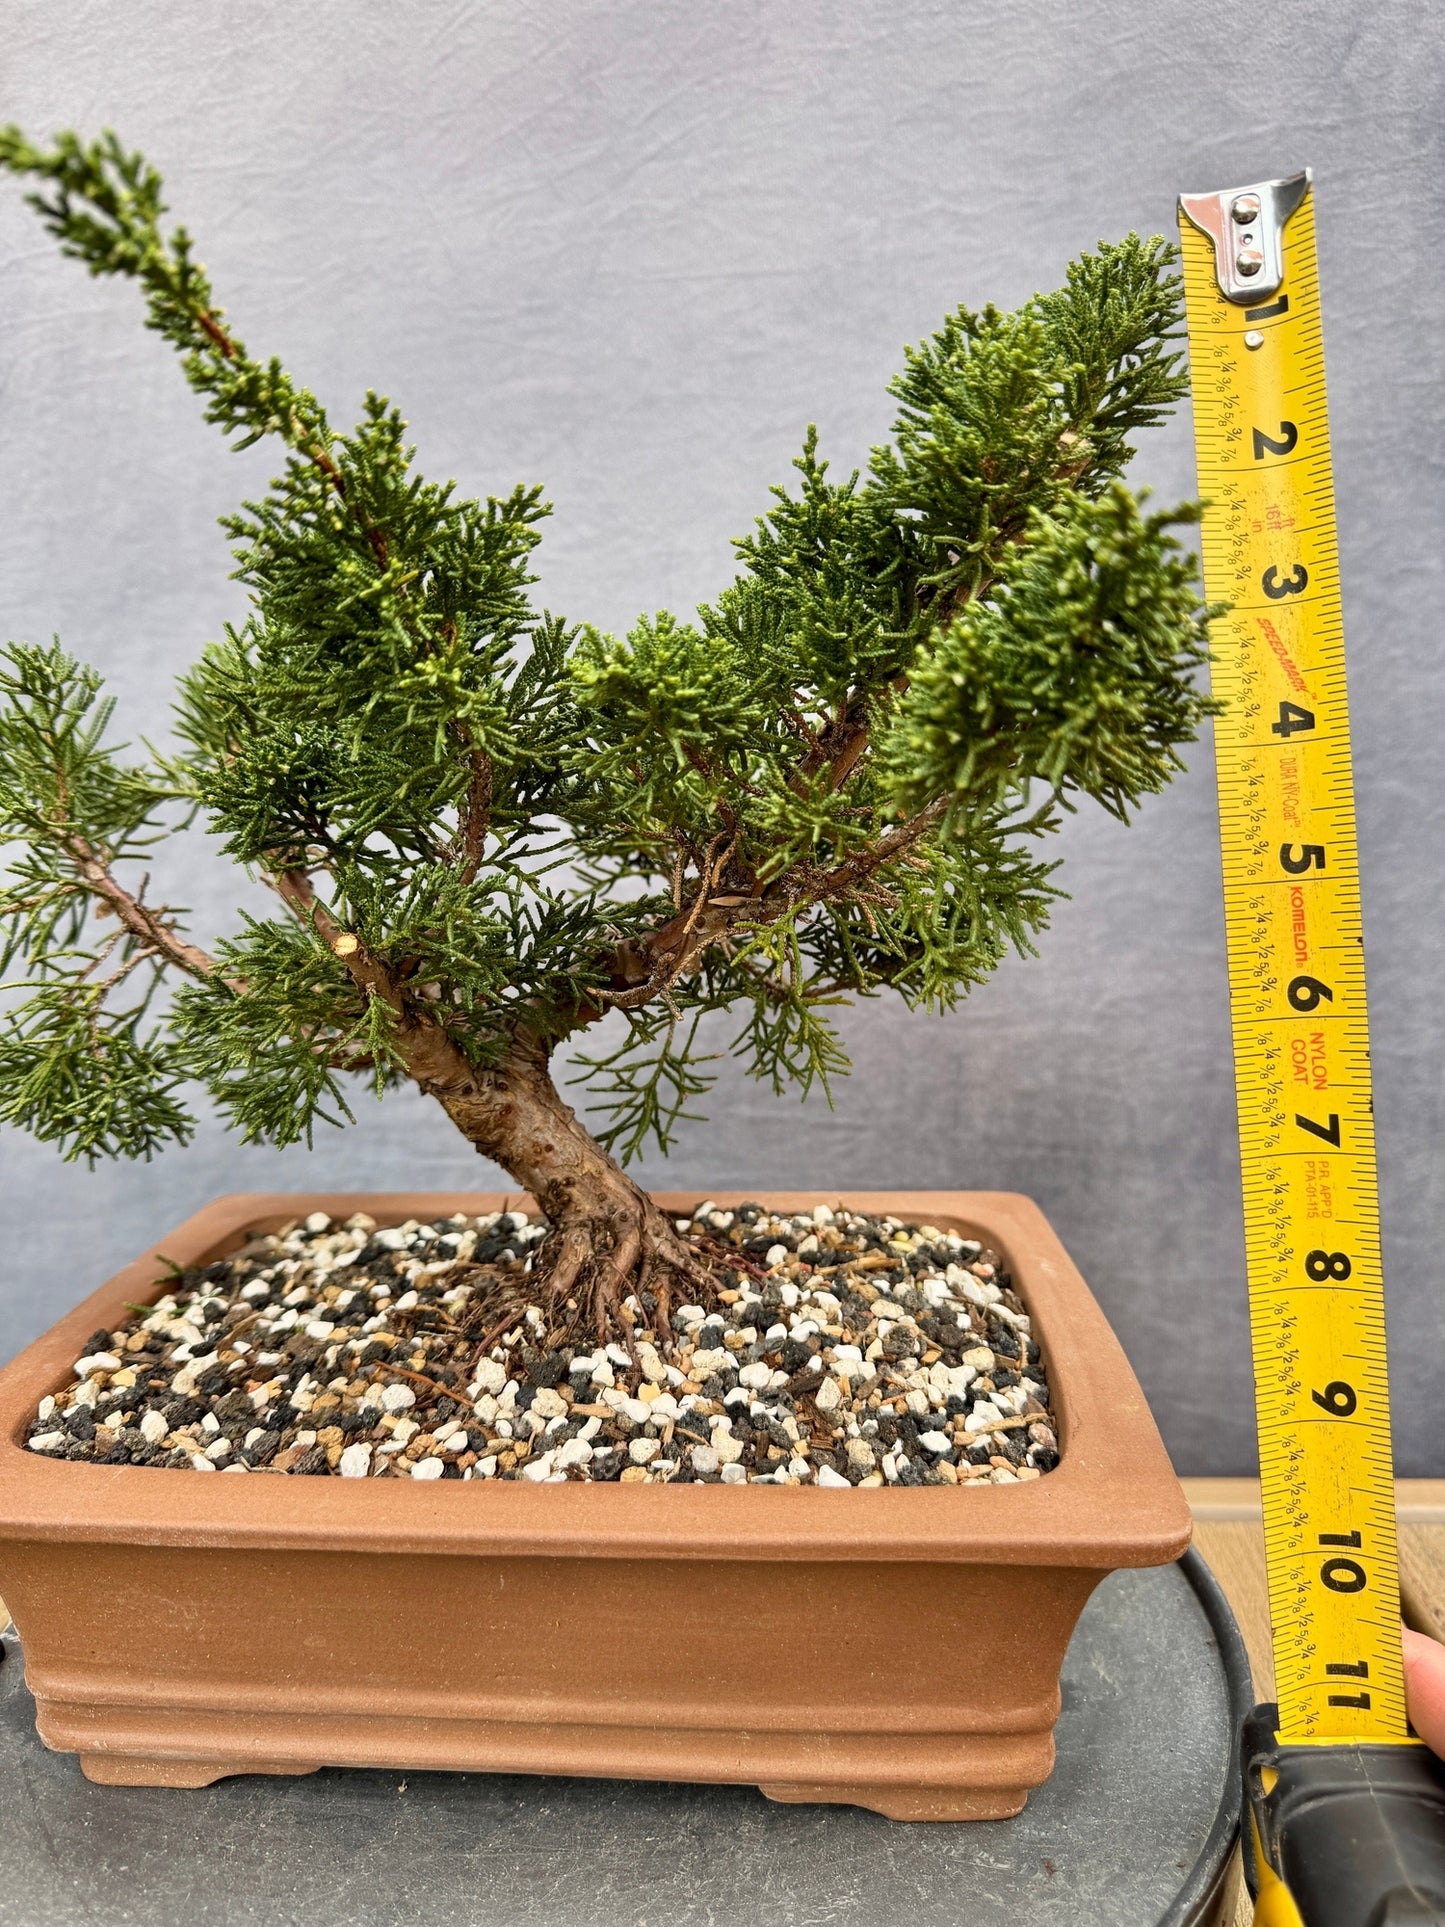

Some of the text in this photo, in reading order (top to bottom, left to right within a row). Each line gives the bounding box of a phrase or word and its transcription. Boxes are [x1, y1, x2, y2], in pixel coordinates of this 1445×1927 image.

[1245, 294, 1289, 322] 1
[1252, 421, 1298, 460] 2
[1262, 564, 1308, 599] 3
[1272, 701, 1315, 737] 4
[1280, 843, 1325, 874] 5
[1287, 975, 1333, 1012] 6
[1310, 1032, 1327, 1090] NYLON
[1295, 1114, 1340, 1148] 7
[1305, 1250, 1351, 1282] 8
[1312, 1381, 1357, 1417] 9
[1318, 1530, 1366, 1593] 10
[1326, 1661, 1370, 1710] 11
